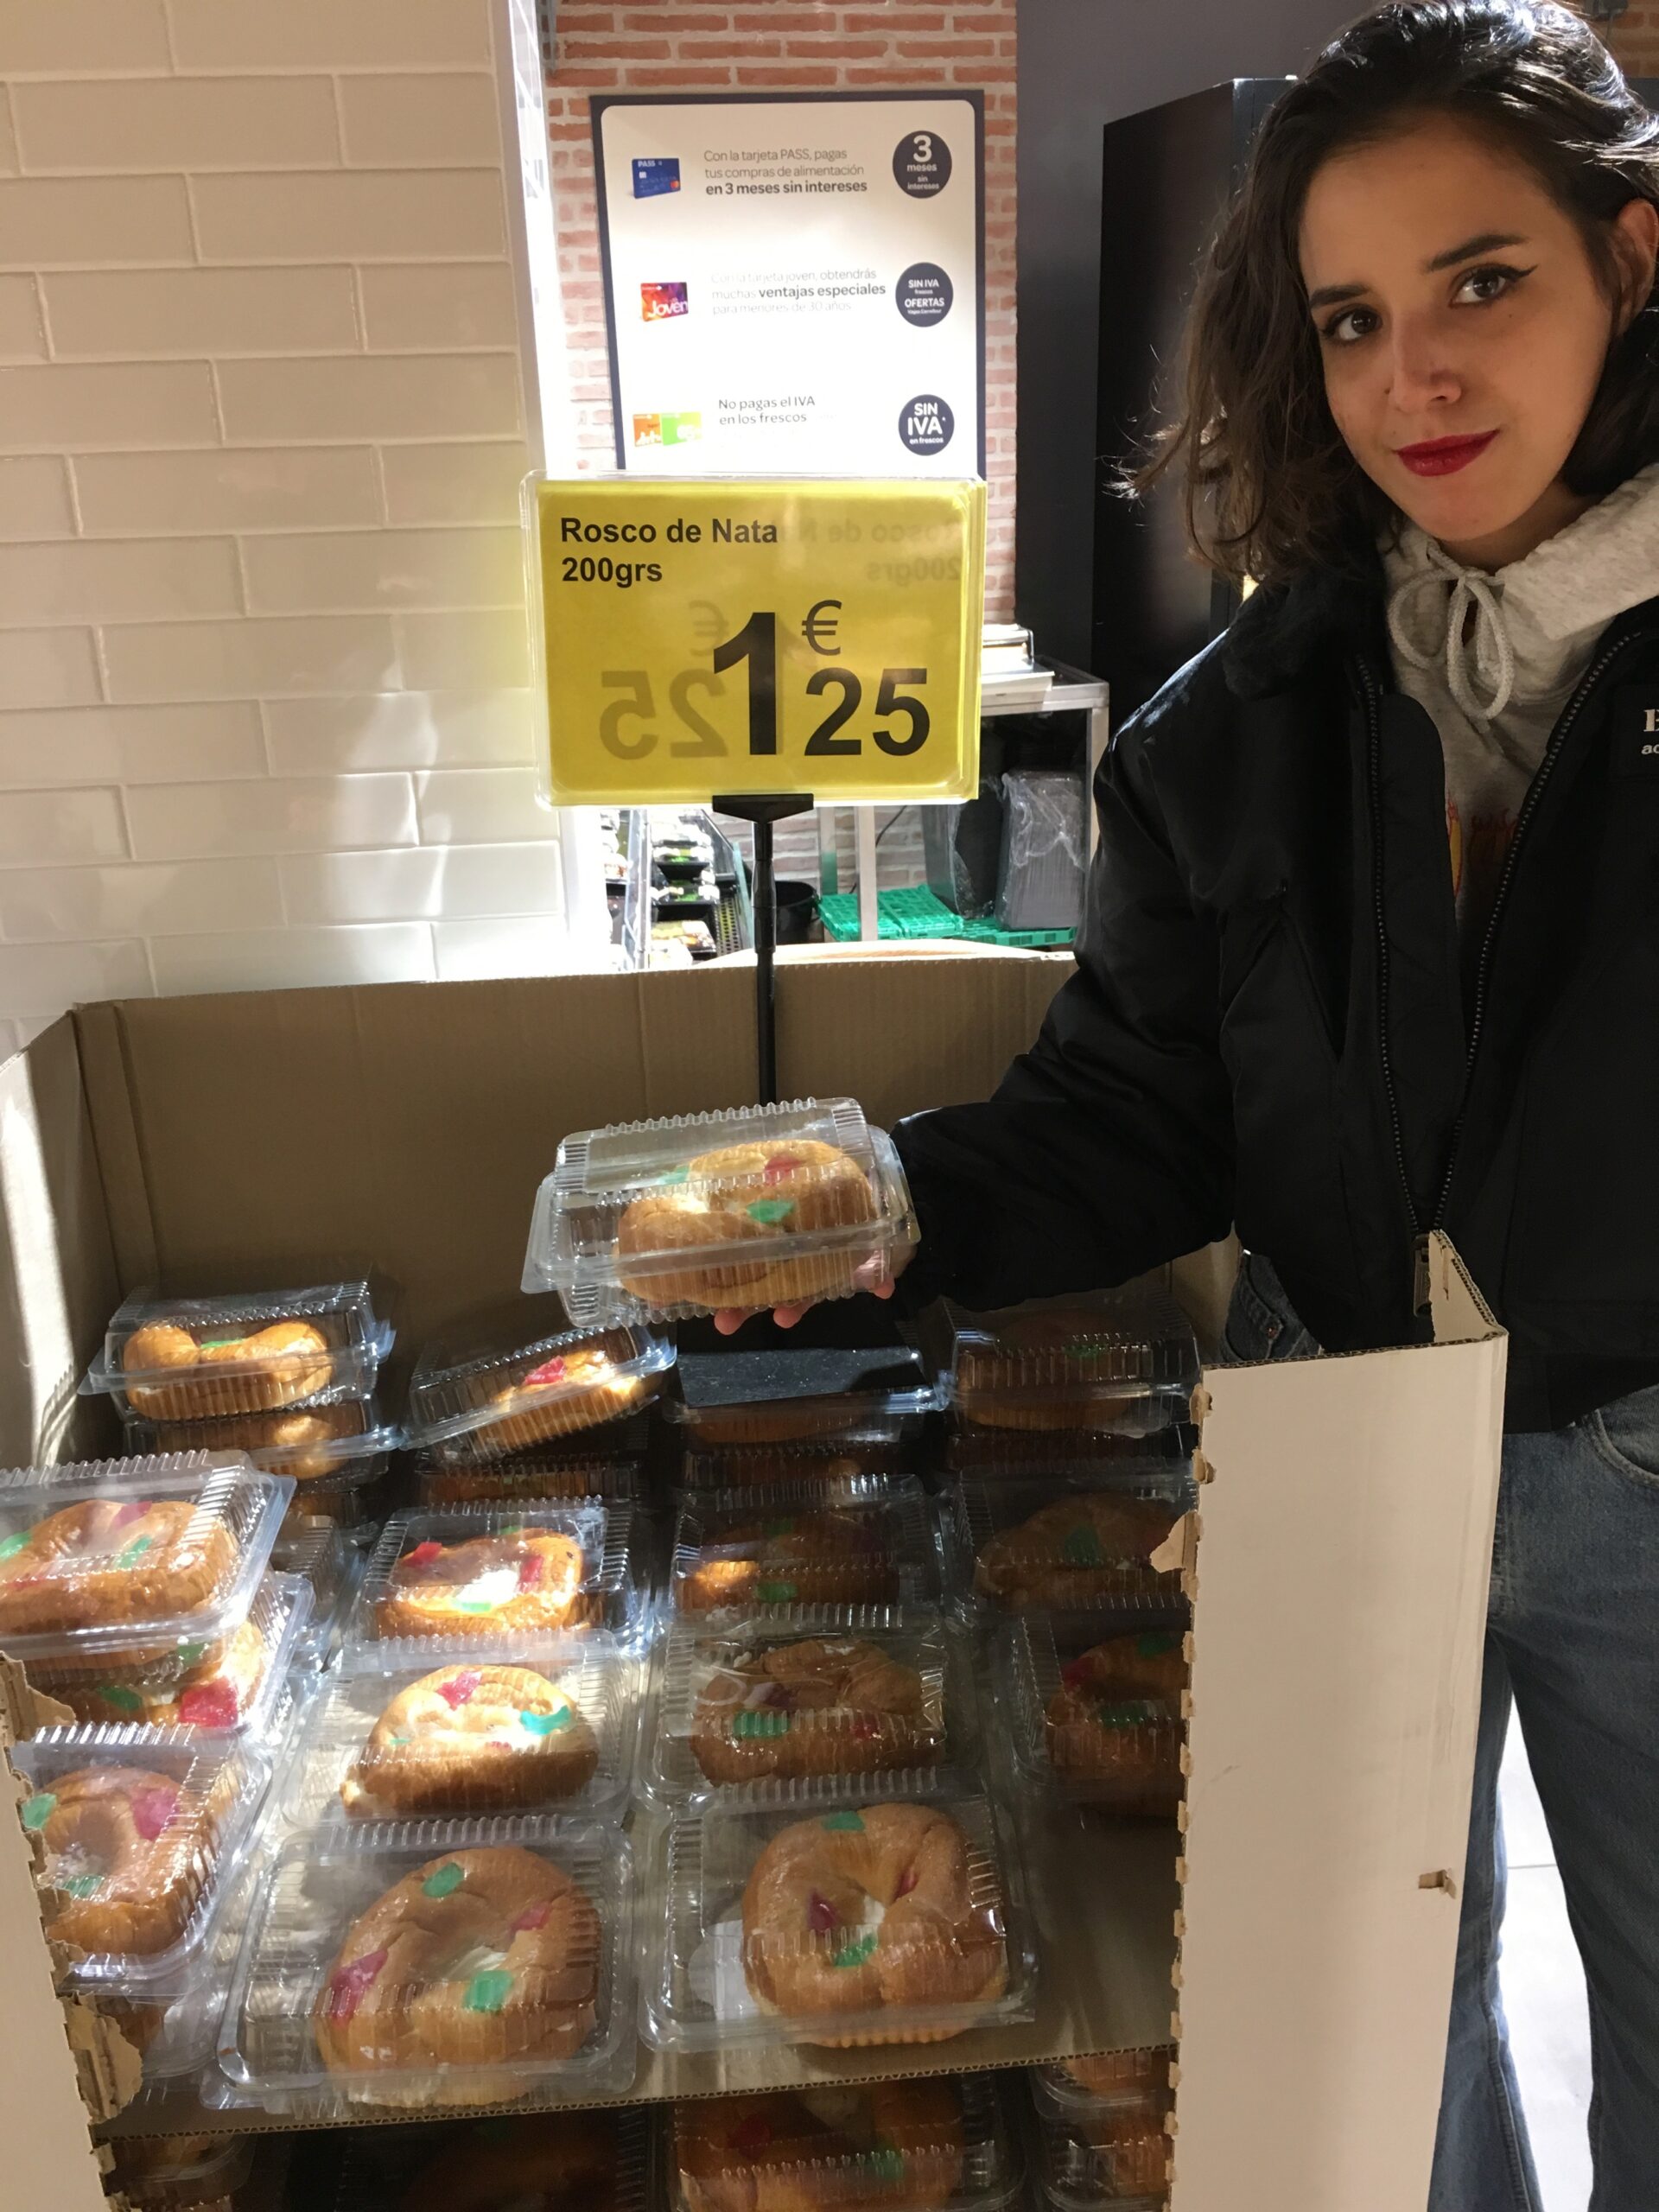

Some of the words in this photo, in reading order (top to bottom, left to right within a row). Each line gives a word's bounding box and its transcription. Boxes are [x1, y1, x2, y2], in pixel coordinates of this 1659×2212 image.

[703, 149, 728, 162] Con
[729, 149, 740, 162] la
[741, 149, 779, 163] tarjeta
[780, 148, 812, 161] PASS,
[814, 149, 848, 162] pagas
[912, 135, 932, 162] 3
[704, 168, 723, 179] tus
[725, 168, 776, 180] compras
[777, 165, 792, 177] de
[793, 164, 865, 176] alimentación
[906, 163, 938, 172] meses
[706, 185, 722, 195] en
[725, 182, 734, 194] 3
[736, 183, 781, 194] meses
[783, 180, 804, 194] sin
[805, 180, 868, 193] intereses
[907, 181, 940, 190] intereses
[820, 268, 877, 281] obtendrás
[908, 279, 924, 289] SIN
[925, 278, 940, 288] IVA
[712, 289, 757, 299] muchas
[759, 284, 815, 300] ventajas
[817, 283, 887, 299] especiales
[646, 299, 689, 317] Joven
[713, 304, 739, 316] para
[740, 303, 789, 313] menores
[791, 301, 806, 312] de
[904, 297, 945, 308] OFERTAS
[718, 399, 737, 410] No
[739, 398, 778, 411] pagas
[780, 396, 791, 408] el
[793, 396, 816, 407] IVA
[914, 402, 938, 416] SIN
[719, 416, 735, 425] en
[738, 413, 757, 424] los
[760, 412, 807, 423] frescos
[561, 517, 657, 543] Rosco
[666, 518, 701, 543] de
[712, 518, 778, 543] Nata
[562, 557, 663, 588] 200grs
[802, 600, 842, 656] €
[713, 612, 778, 756] 1
[804, 667, 931, 756] 25
